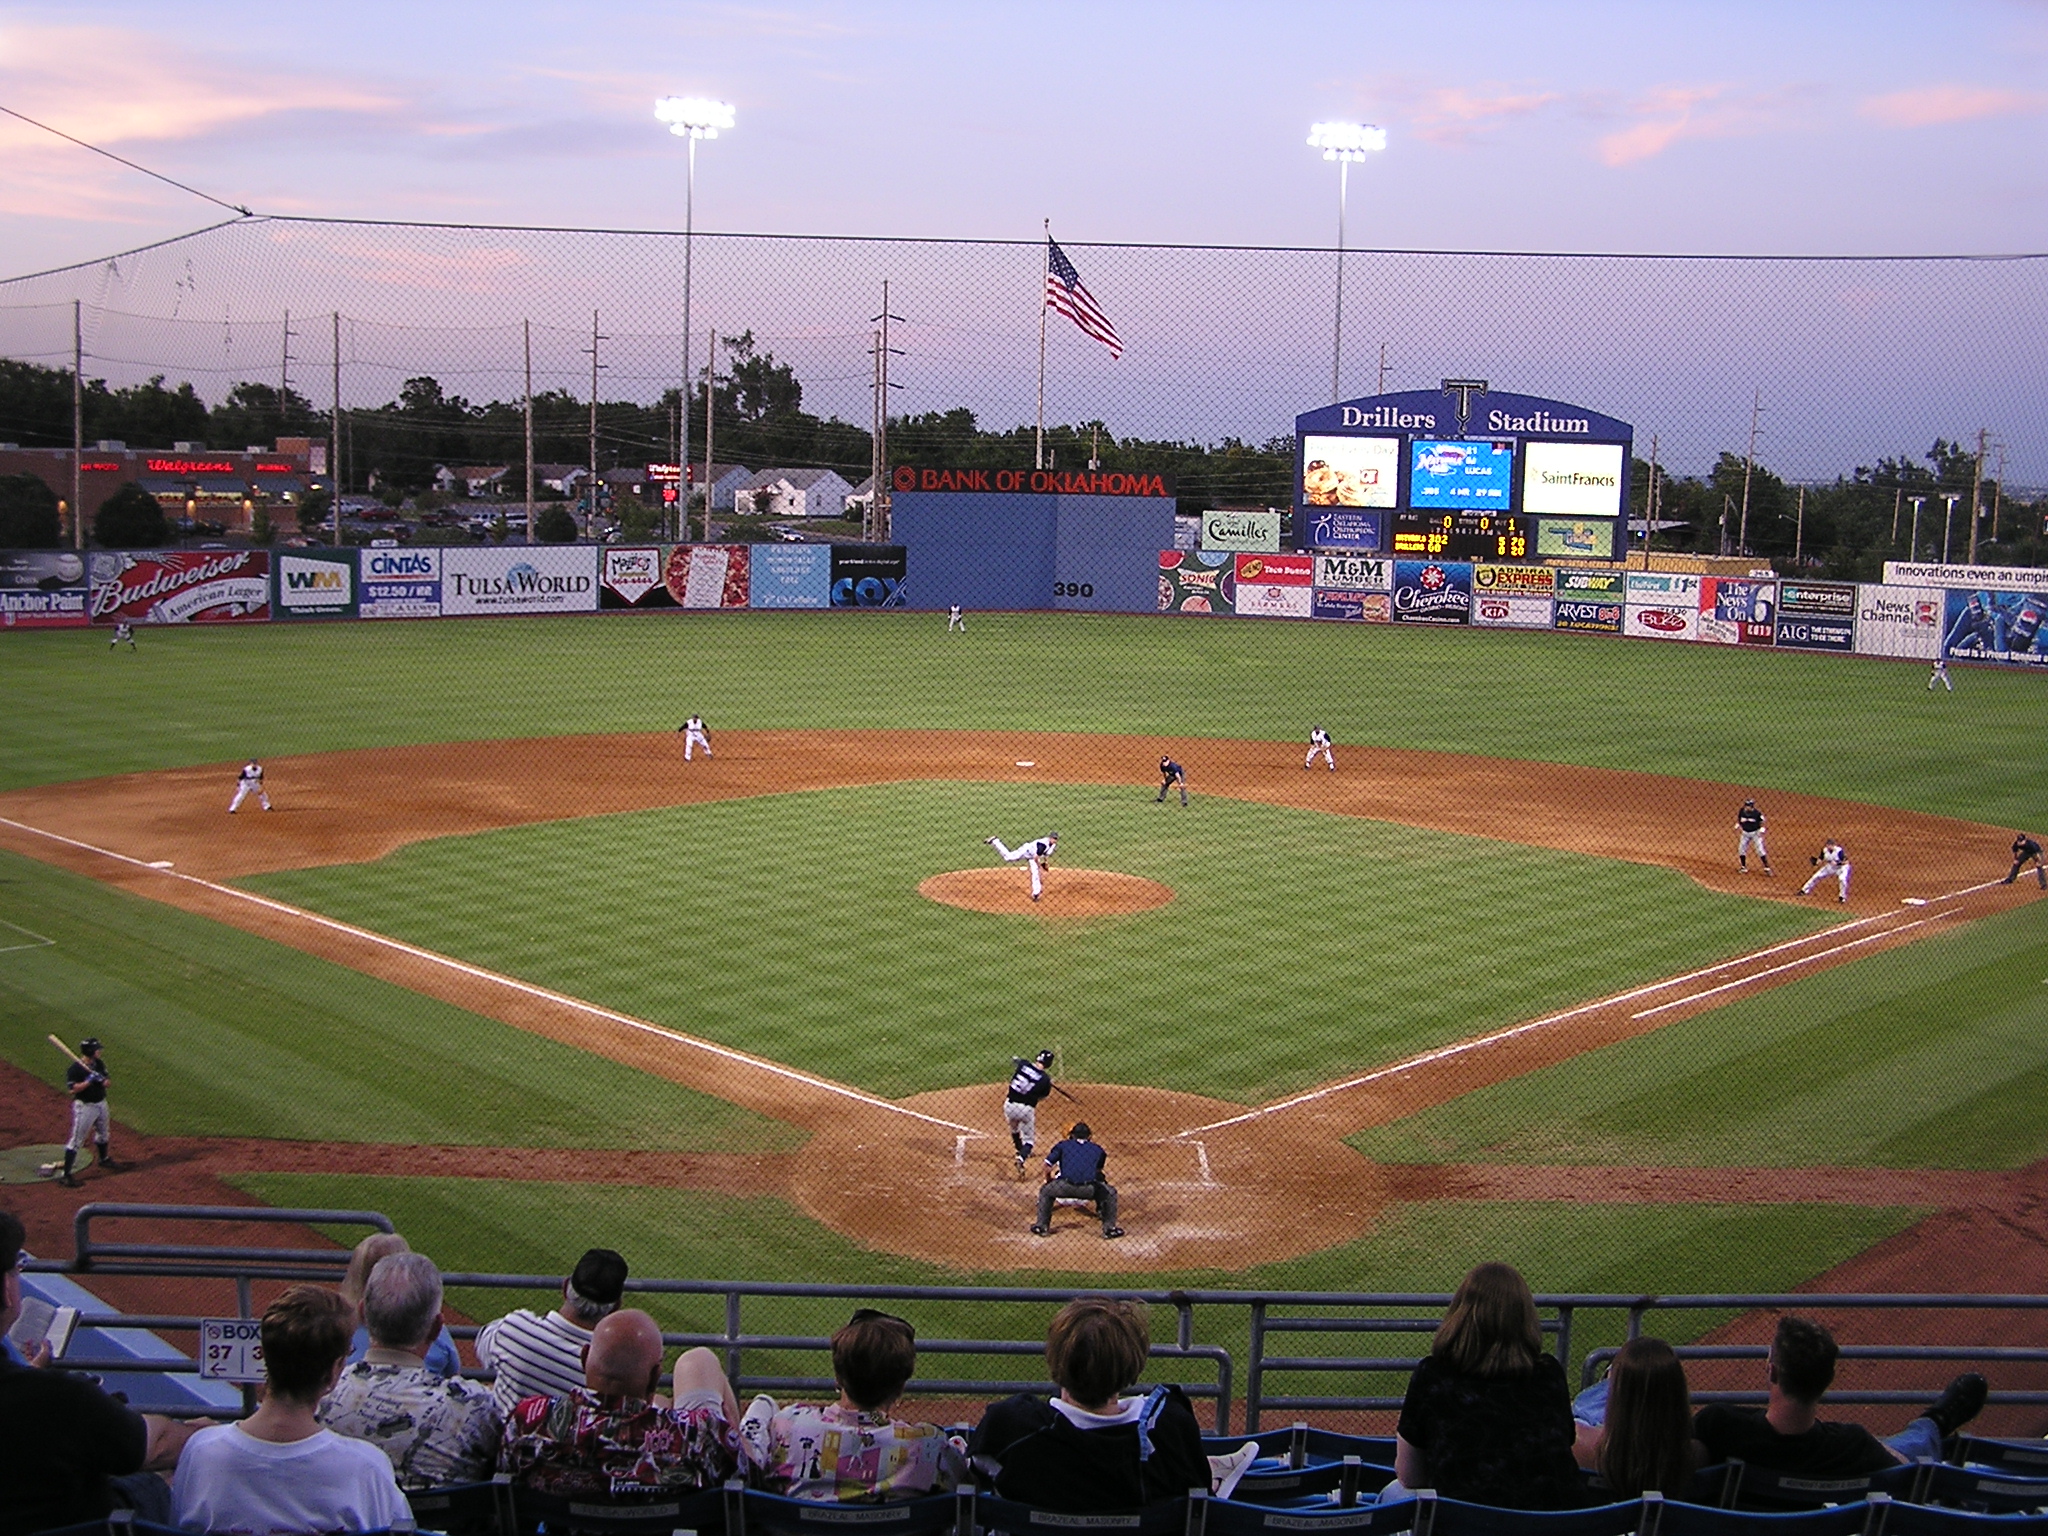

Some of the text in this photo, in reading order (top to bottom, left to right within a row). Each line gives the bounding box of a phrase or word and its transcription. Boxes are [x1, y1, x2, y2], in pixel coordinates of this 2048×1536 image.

[1341, 406, 1589, 434] Drillers Stadium
[147, 459, 234, 475] Walgreens
[921, 469, 1168, 497] BANK OF OKLAHOMA
[1443, 515, 1453, 529] 0
[1480, 517, 1489, 530] 0
[1508, 517, 1516, 531] 1
[1208, 520, 1268, 542] Camille's
[370, 552, 432, 574] CINTAS
[1263, 565, 1311, 575] Taco Bueno
[1324, 558, 1384, 577] M&M
[1498, 567, 1552, 575] ADMIRAL
[1895, 565, 1965, 580] Innovations
[1967, 570, 1995, 581] even
[1997, 571, 2012, 581] an
[91, 551, 250, 618] Budweiser
[451, 572, 590, 596] TULSA WORLD
[1181, 574, 1215, 584] SONIC
[1323, 576, 1384, 584] LUMBER
[1497, 573, 1553, 586] EXPRESS
[1564, 575, 1615, 590] SUBWAY
[831, 577, 908, 607] COX
[1053, 582, 1094, 598] 390
[1394, 583, 1469, 610] Cherokee
[1725, 582, 1749, 596] The
[1788, 589, 1850, 603] enterprise
[0, 592, 84, 611] Anchor Paint
[169, 585, 263, 618] American Lager
[1717, 593, 1749, 608] News
[1876, 599, 1911, 613] News
[1485, 608, 1505, 617] KIA
[1557, 602, 1600, 621] ARVEST
[1726, 607, 1747, 621] On
[1861, 608, 1914, 624] Channel
[1640, 613, 1683, 629] Buzz
[1778, 625, 1808, 641] AIG
[223, 1325, 263, 1340] BOX
[208, 1345, 233, 1359] 37
[808, 1510, 902, 1520] BRAZEAL MASONRY
[1086, 1517, 1132, 1525] MASONRY
[1272, 1516, 1364, 1527] BRAZEAL MASONRY
